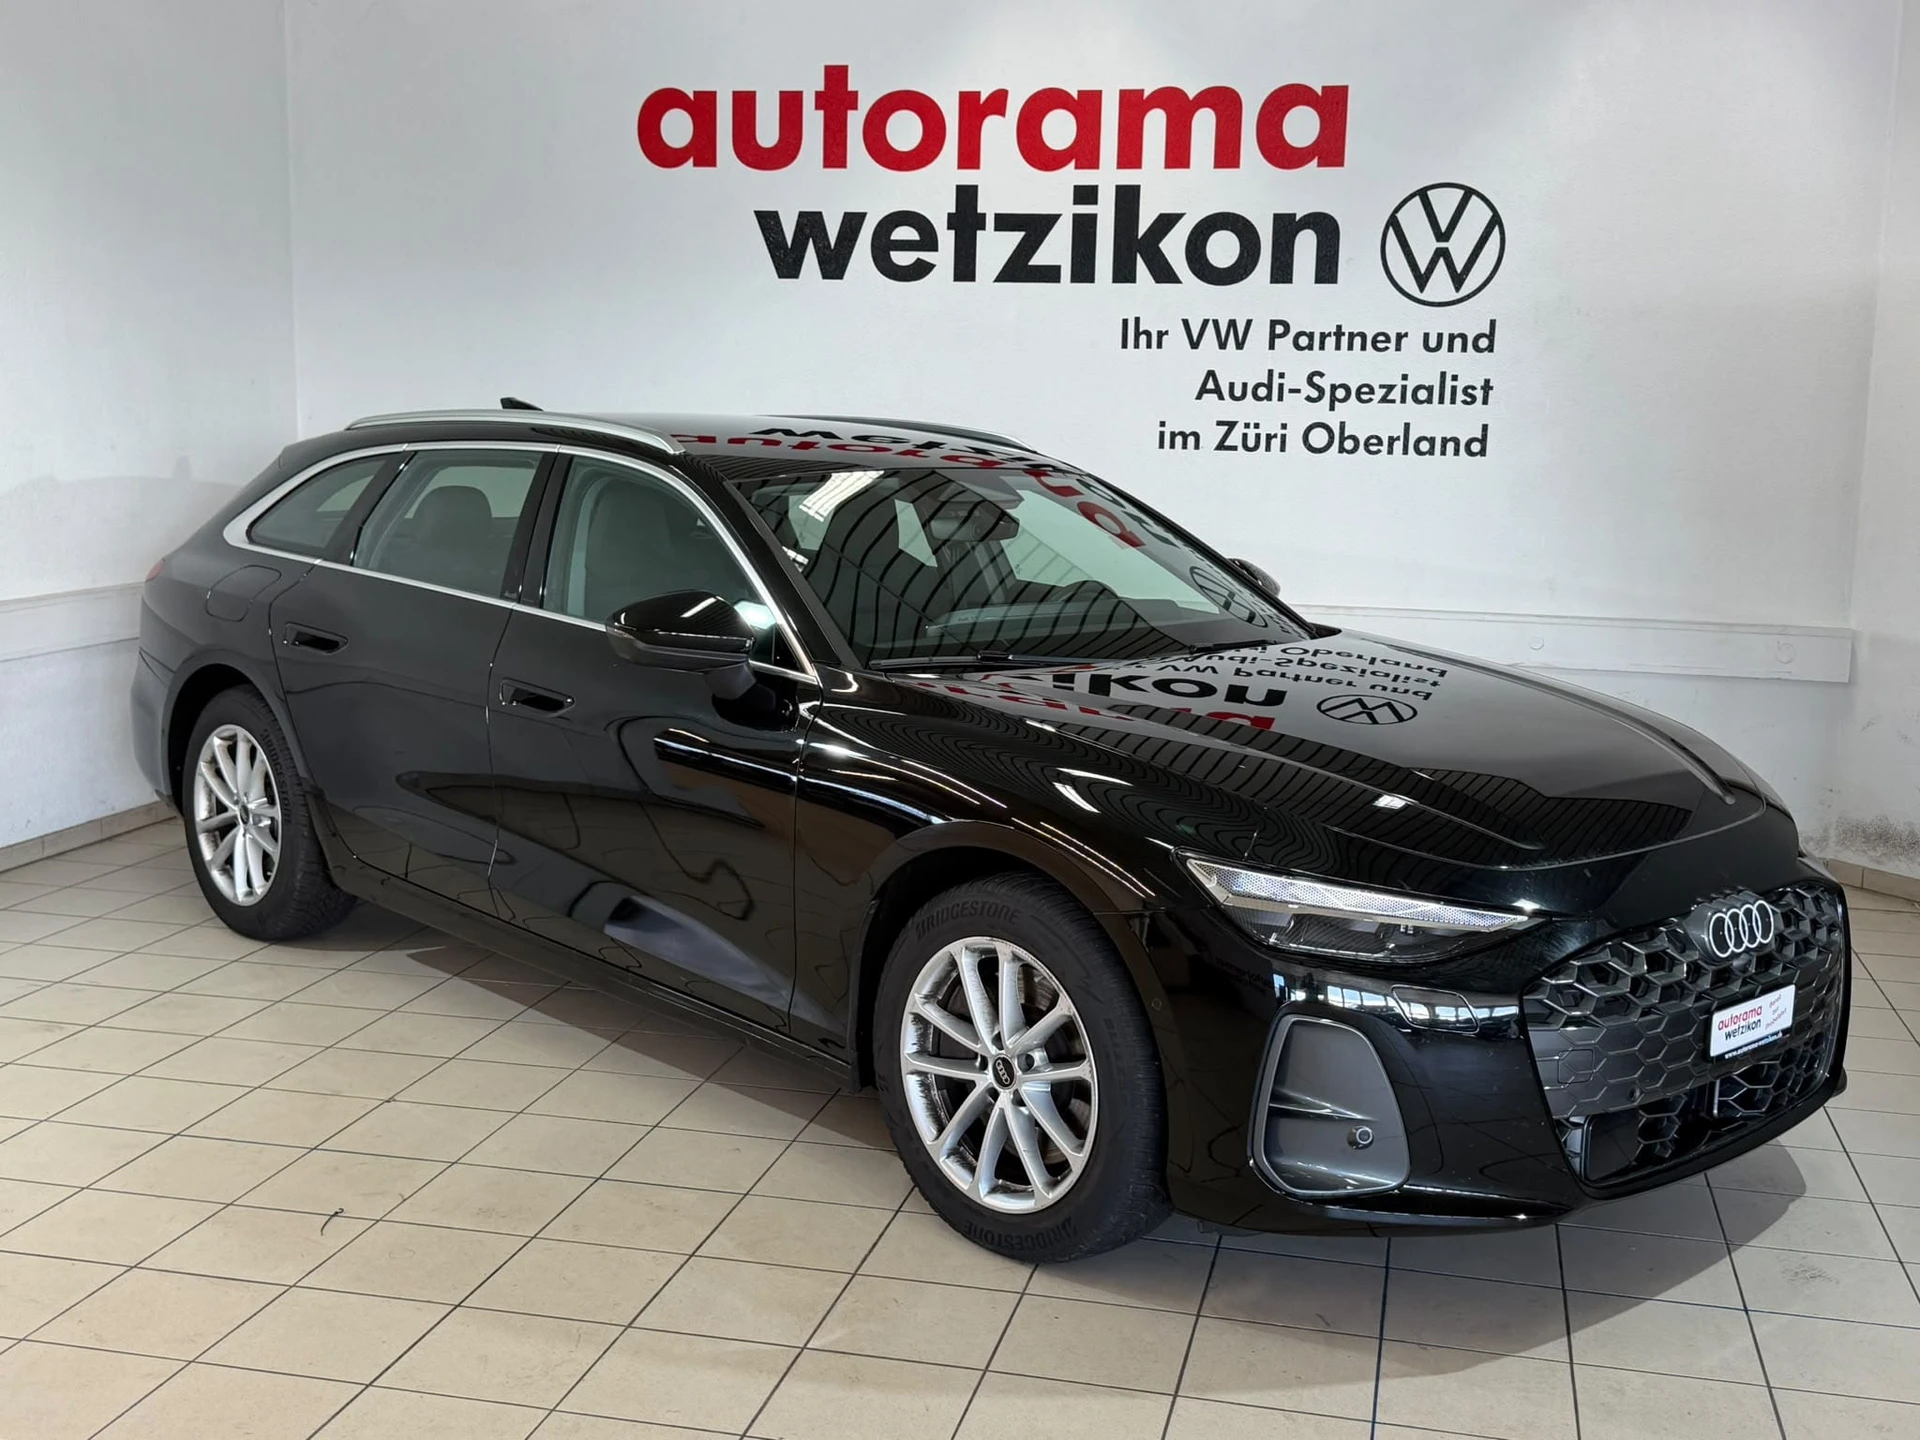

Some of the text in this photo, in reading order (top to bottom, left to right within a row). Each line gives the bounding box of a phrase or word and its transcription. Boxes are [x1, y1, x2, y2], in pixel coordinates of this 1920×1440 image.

[637, 65, 1348, 171] autorama
[754, 185, 1340, 286] wetzikon
[1121, 317, 1497, 354] Ihr VW Partner und
[1195, 369, 1493, 411] Audi-Spezialist
[1159, 420, 1488, 458] im Züri Oberland
[915, 899, 1021, 942] BRIDGESTONE
[1717, 1005, 1763, 1031] autorama
[1724, 1018, 1761, 1041] wetzikon
